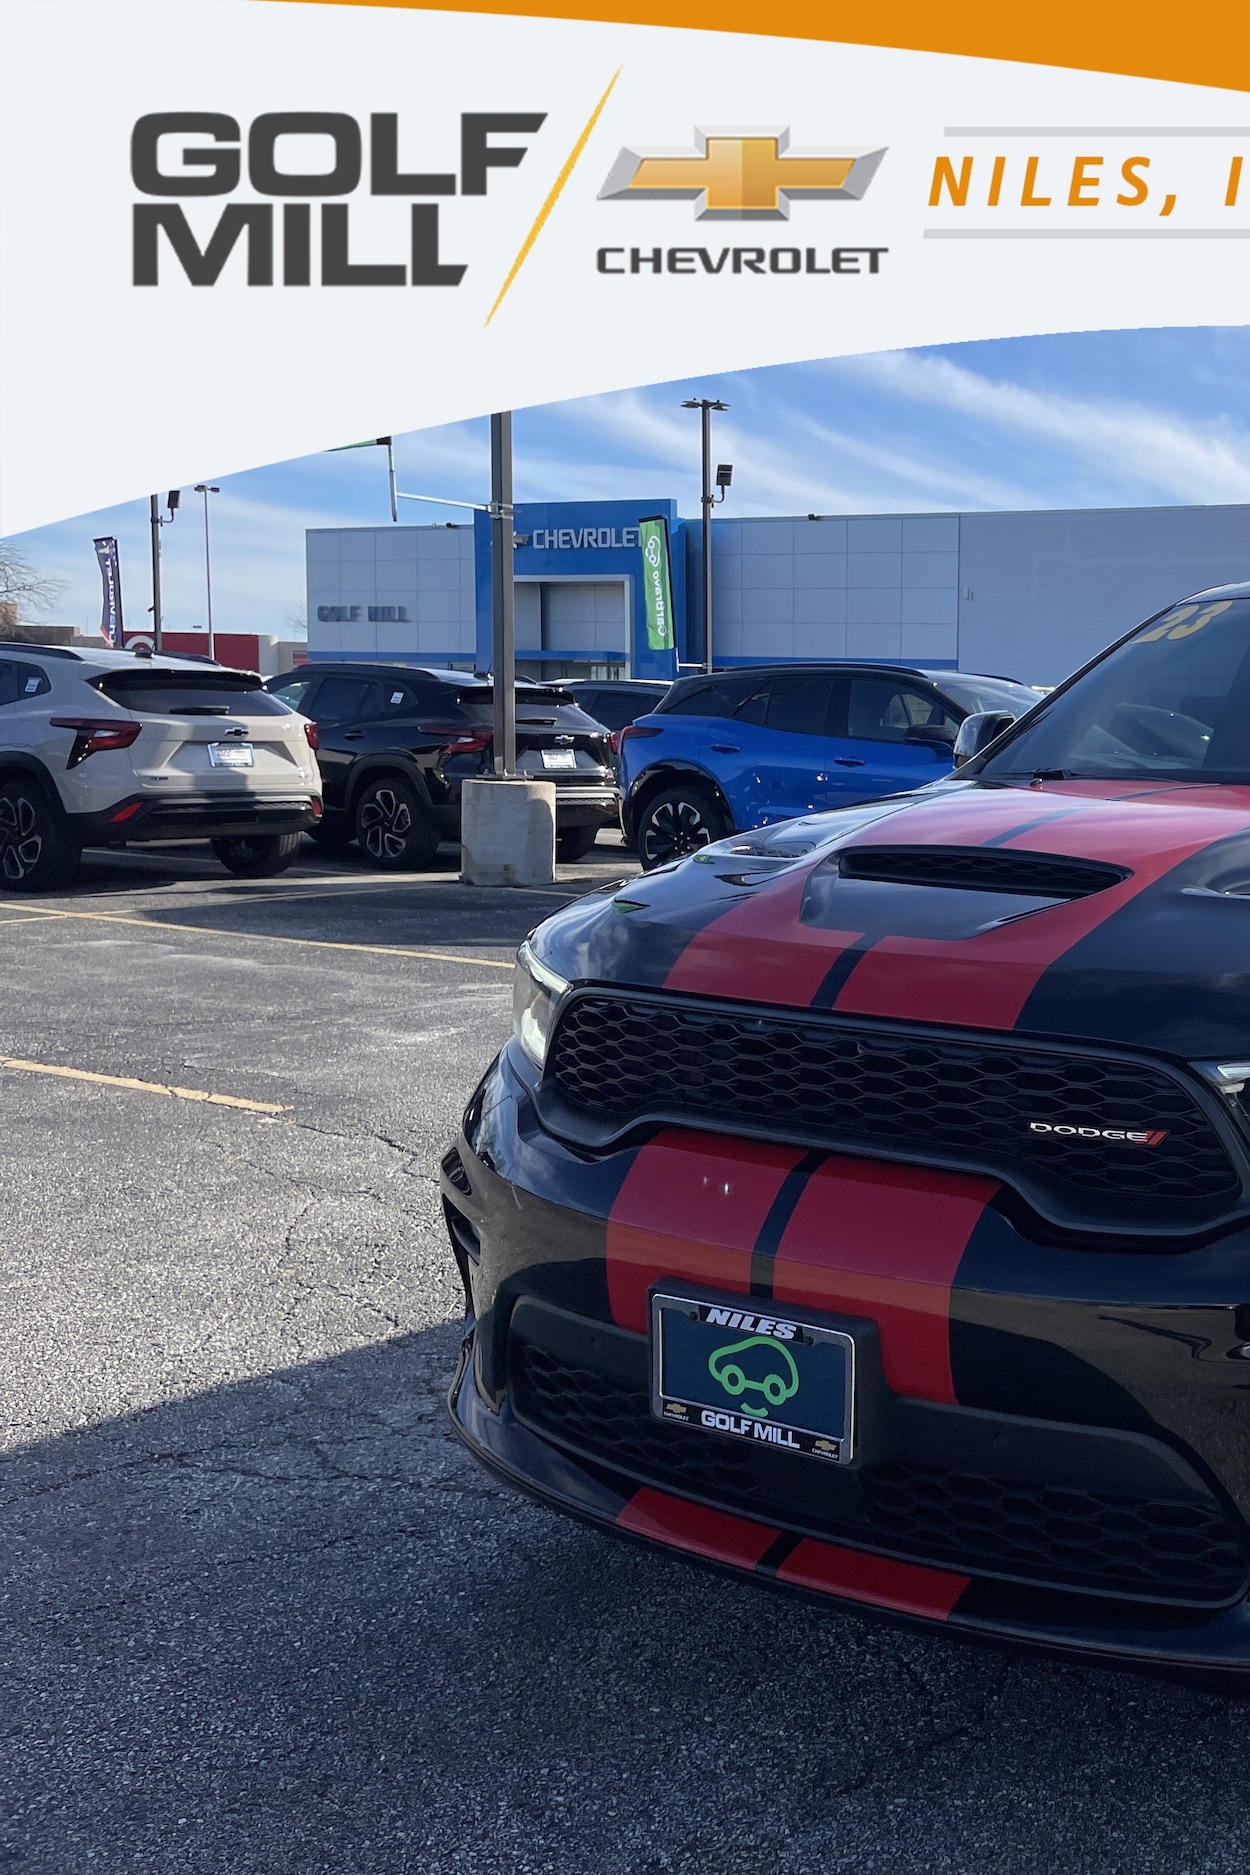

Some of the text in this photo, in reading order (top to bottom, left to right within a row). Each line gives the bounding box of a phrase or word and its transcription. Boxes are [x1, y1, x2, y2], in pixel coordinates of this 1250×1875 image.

[317, 606, 409, 622] GOLF MILL
[1130, 601, 1233, 644] 23
[1030, 1122, 1149, 1142] DODGE
[706, 1308, 797, 1340] NILES
[701, 1410, 800, 1449] GOLF MILL
